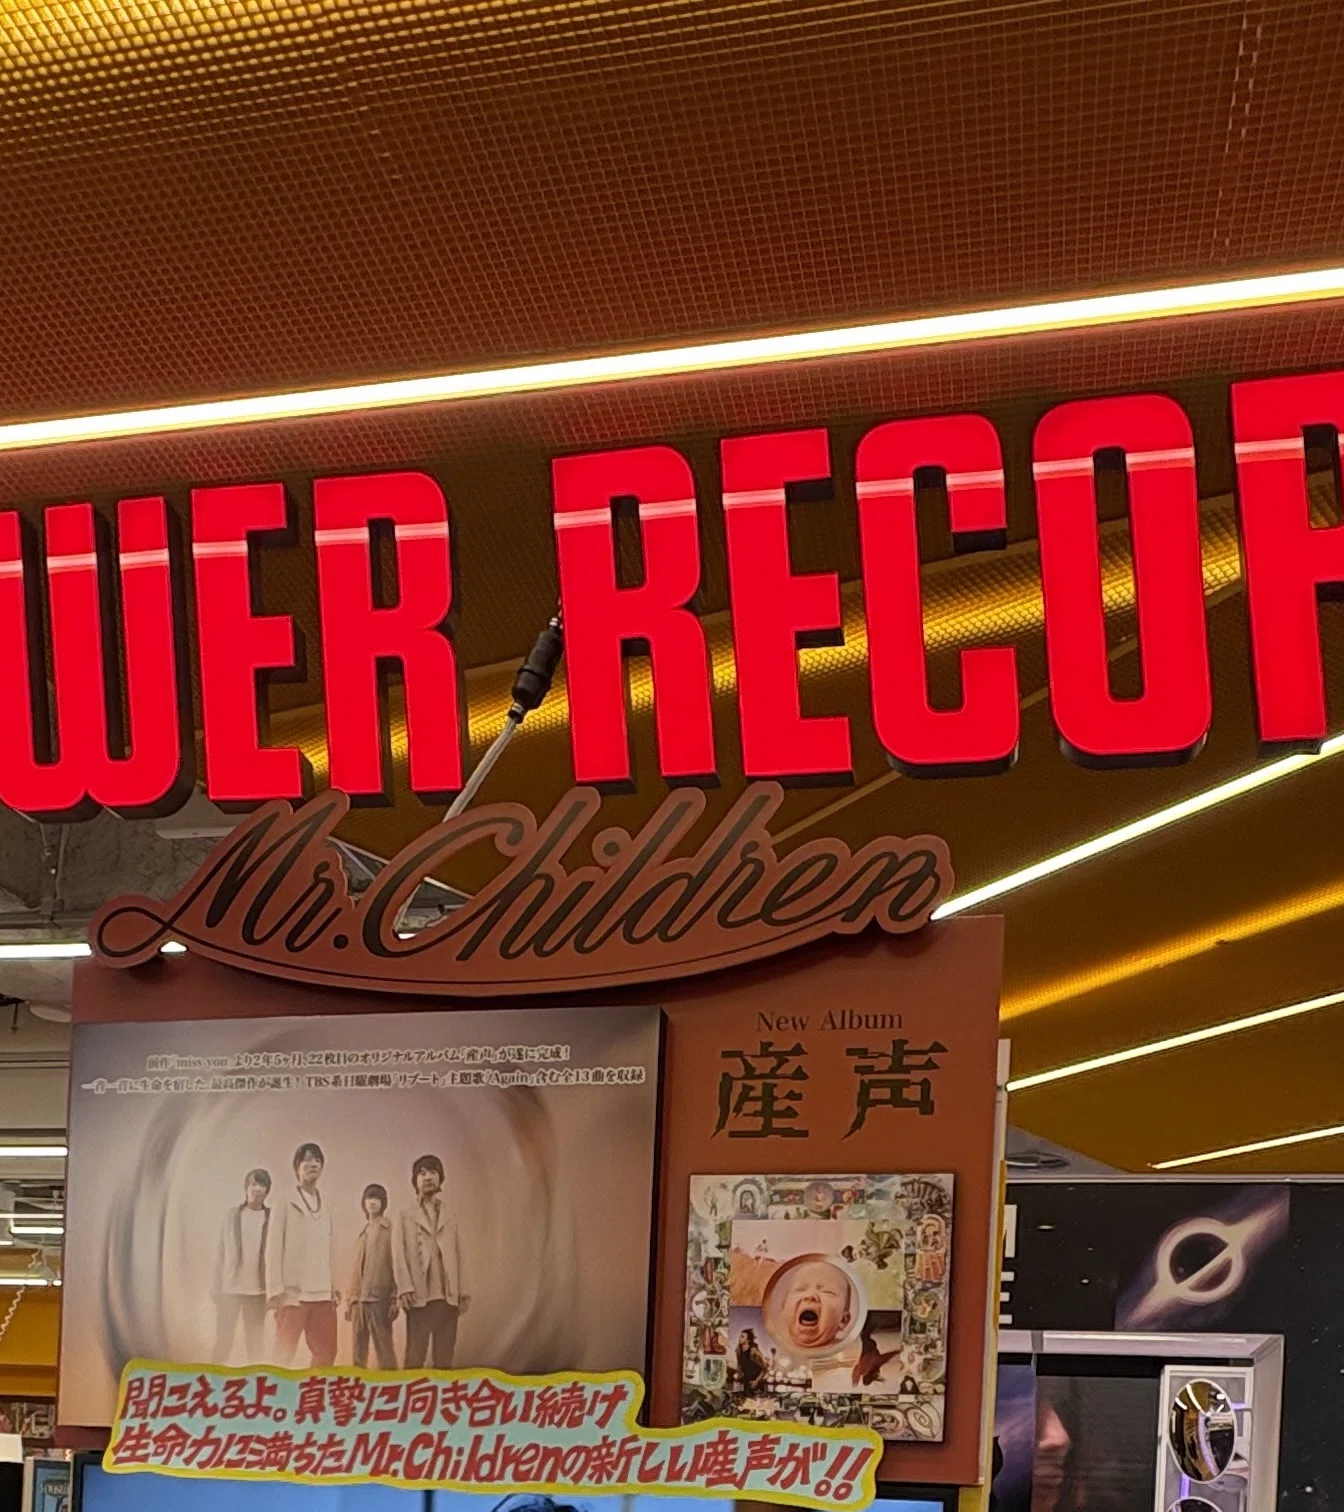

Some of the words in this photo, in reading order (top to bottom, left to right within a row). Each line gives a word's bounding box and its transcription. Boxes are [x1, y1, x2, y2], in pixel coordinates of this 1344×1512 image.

[756, 1009, 806, 1032] New
[817, 1007, 904, 1033] Album
[712, 1040, 949, 1142] 産声
